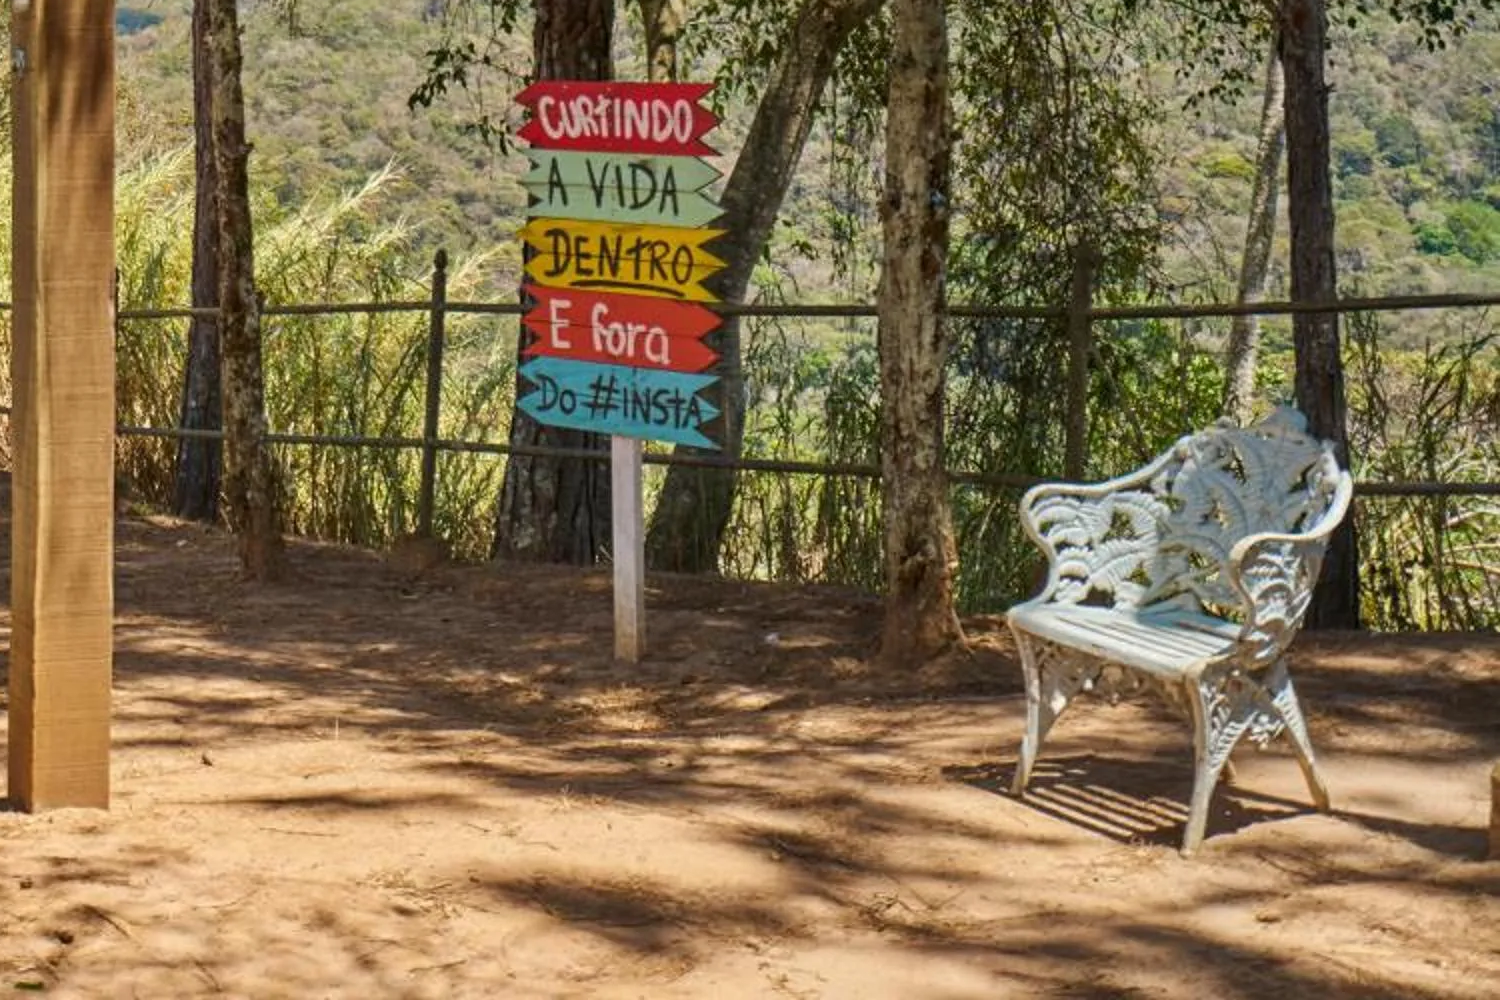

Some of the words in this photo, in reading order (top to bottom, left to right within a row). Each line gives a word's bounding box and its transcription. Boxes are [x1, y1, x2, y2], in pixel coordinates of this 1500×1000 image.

[548, 157, 569, 207] A
[586, 157, 679, 217] VIDA
[550, 298, 572, 349] E
[591, 301, 671, 365] fora
[534, 373, 577, 415] Do
